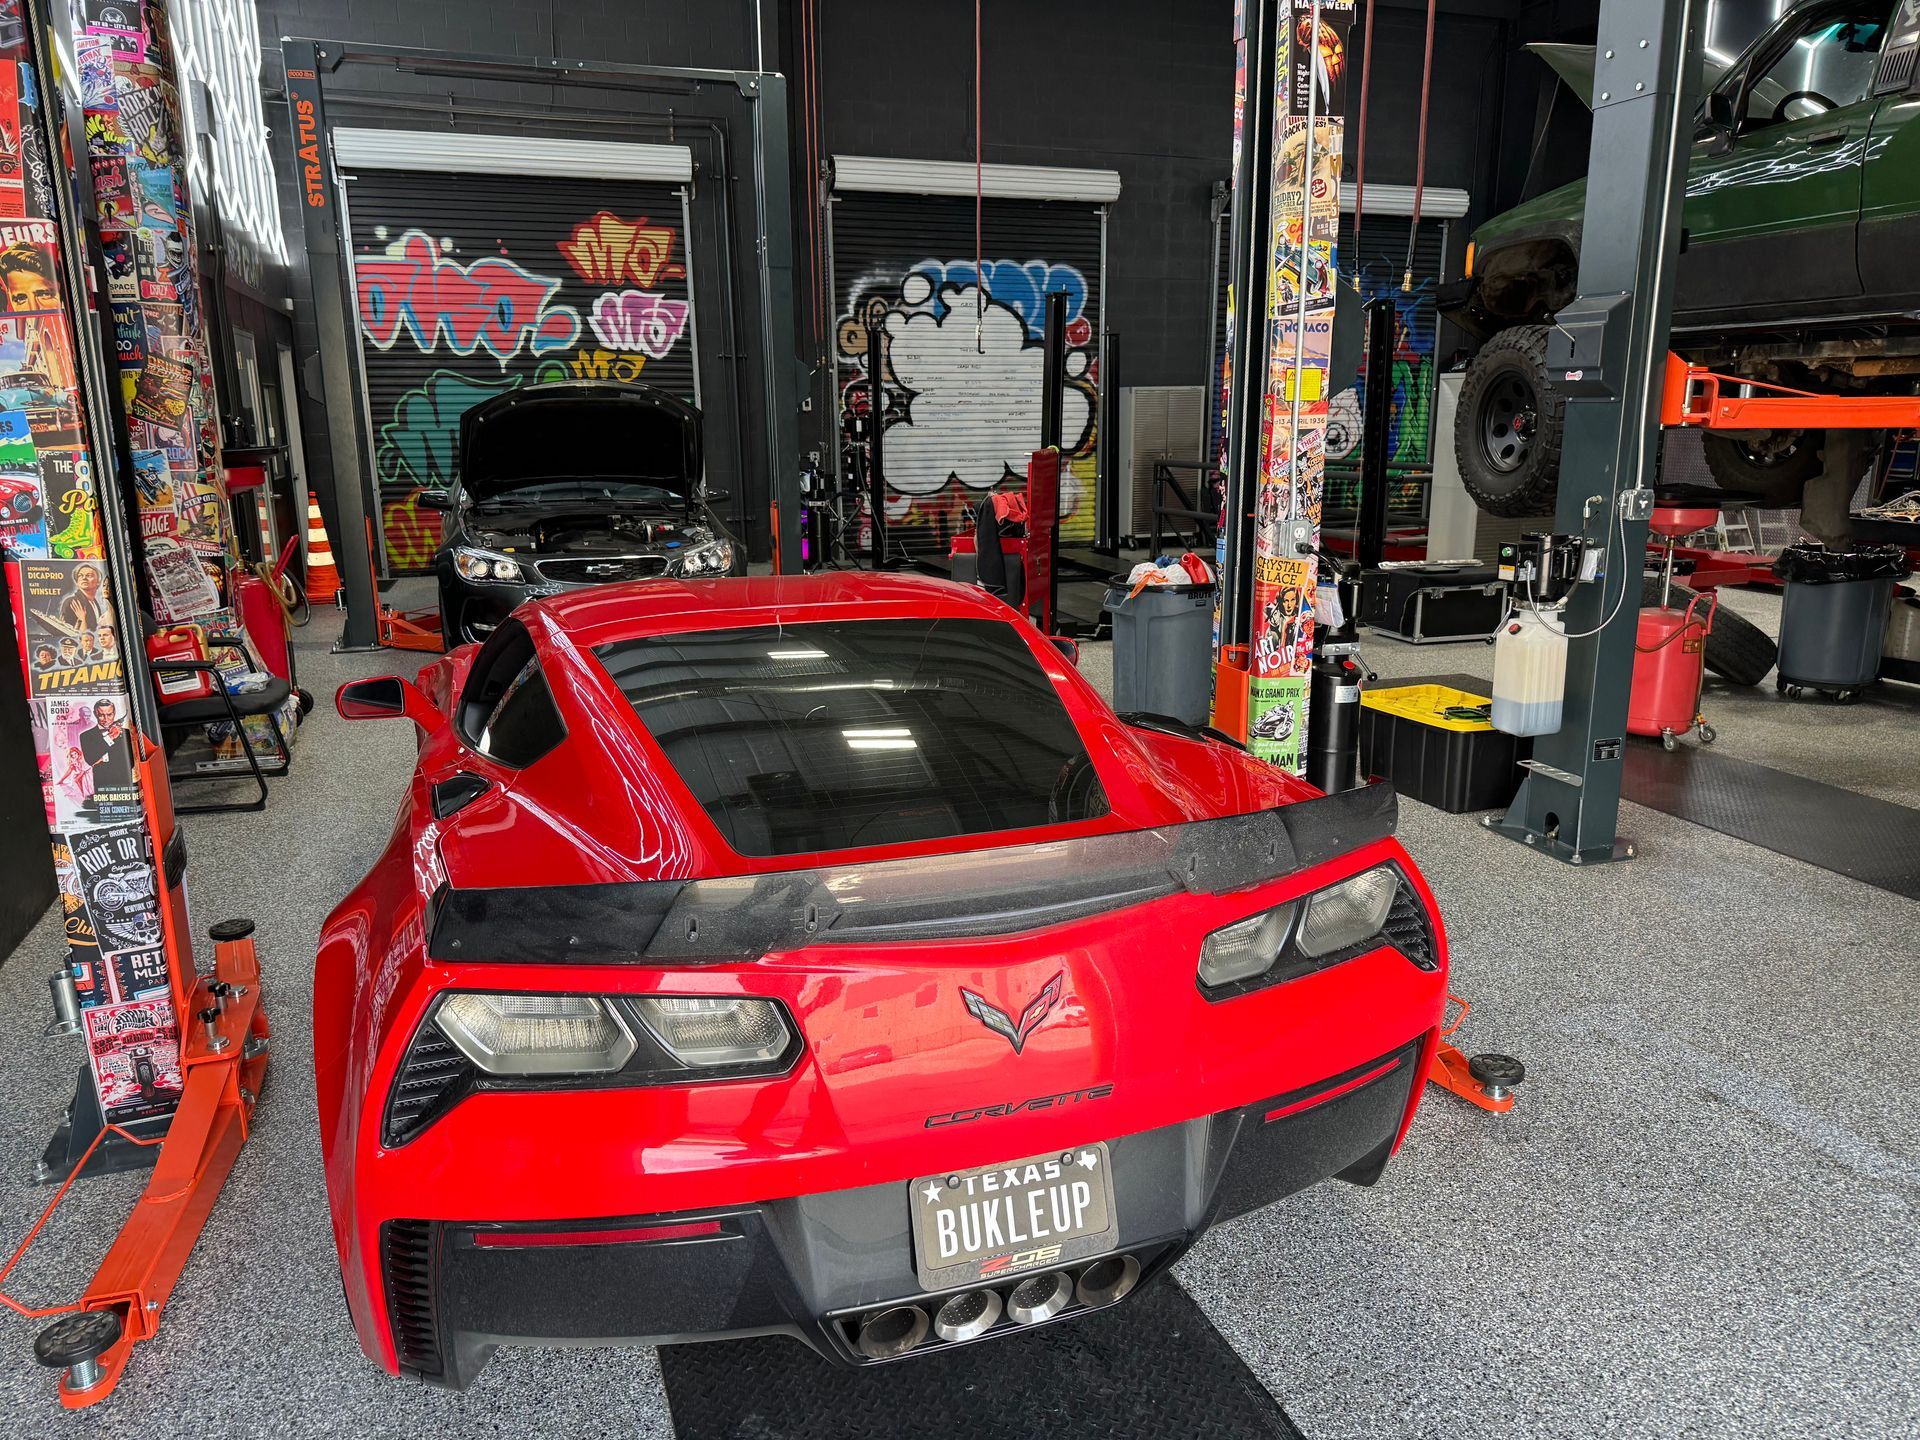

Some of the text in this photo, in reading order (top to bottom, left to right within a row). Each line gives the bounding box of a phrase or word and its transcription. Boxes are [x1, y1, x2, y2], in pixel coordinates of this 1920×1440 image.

[1294, 0, 1352, 10] HAWEEN
[296, 100, 325, 208] STRATUS
[1284, 323, 1329, 333] MOACO
[167, 447, 193, 460] ROCK
[53, 460, 73, 473] THE
[1257, 556, 1303, 575] CRYSTAL
[28, 572, 64, 580] DICAPRIO
[1256, 567, 1298, 586] PALACE
[30, 588, 61, 596] WINSLET
[1254, 636, 1274, 659] ART
[1258, 644, 1296, 675] NOIR
[1265, 687, 1285, 698] GRAND
[1286, 687, 1301, 698] PRIX
[50, 707, 70, 715] BOND
[1270, 753, 1295, 767] MAN
[93, 793, 109, 802] BONS
[110, 793, 131, 802] BAISERS
[99, 806, 111, 814] SEAN
[108, 827, 129, 838] BRONX
[78, 842, 115, 875] RIDE
[117, 837, 140, 860] OR
[924, 1083, 1114, 1128] CORVETTE
[962, 1159, 1061, 1195] TEXAS
[936, 1181, 1091, 1258] BUKLEUP
[980, 1257, 1059, 1278] SUPERCHARGED
